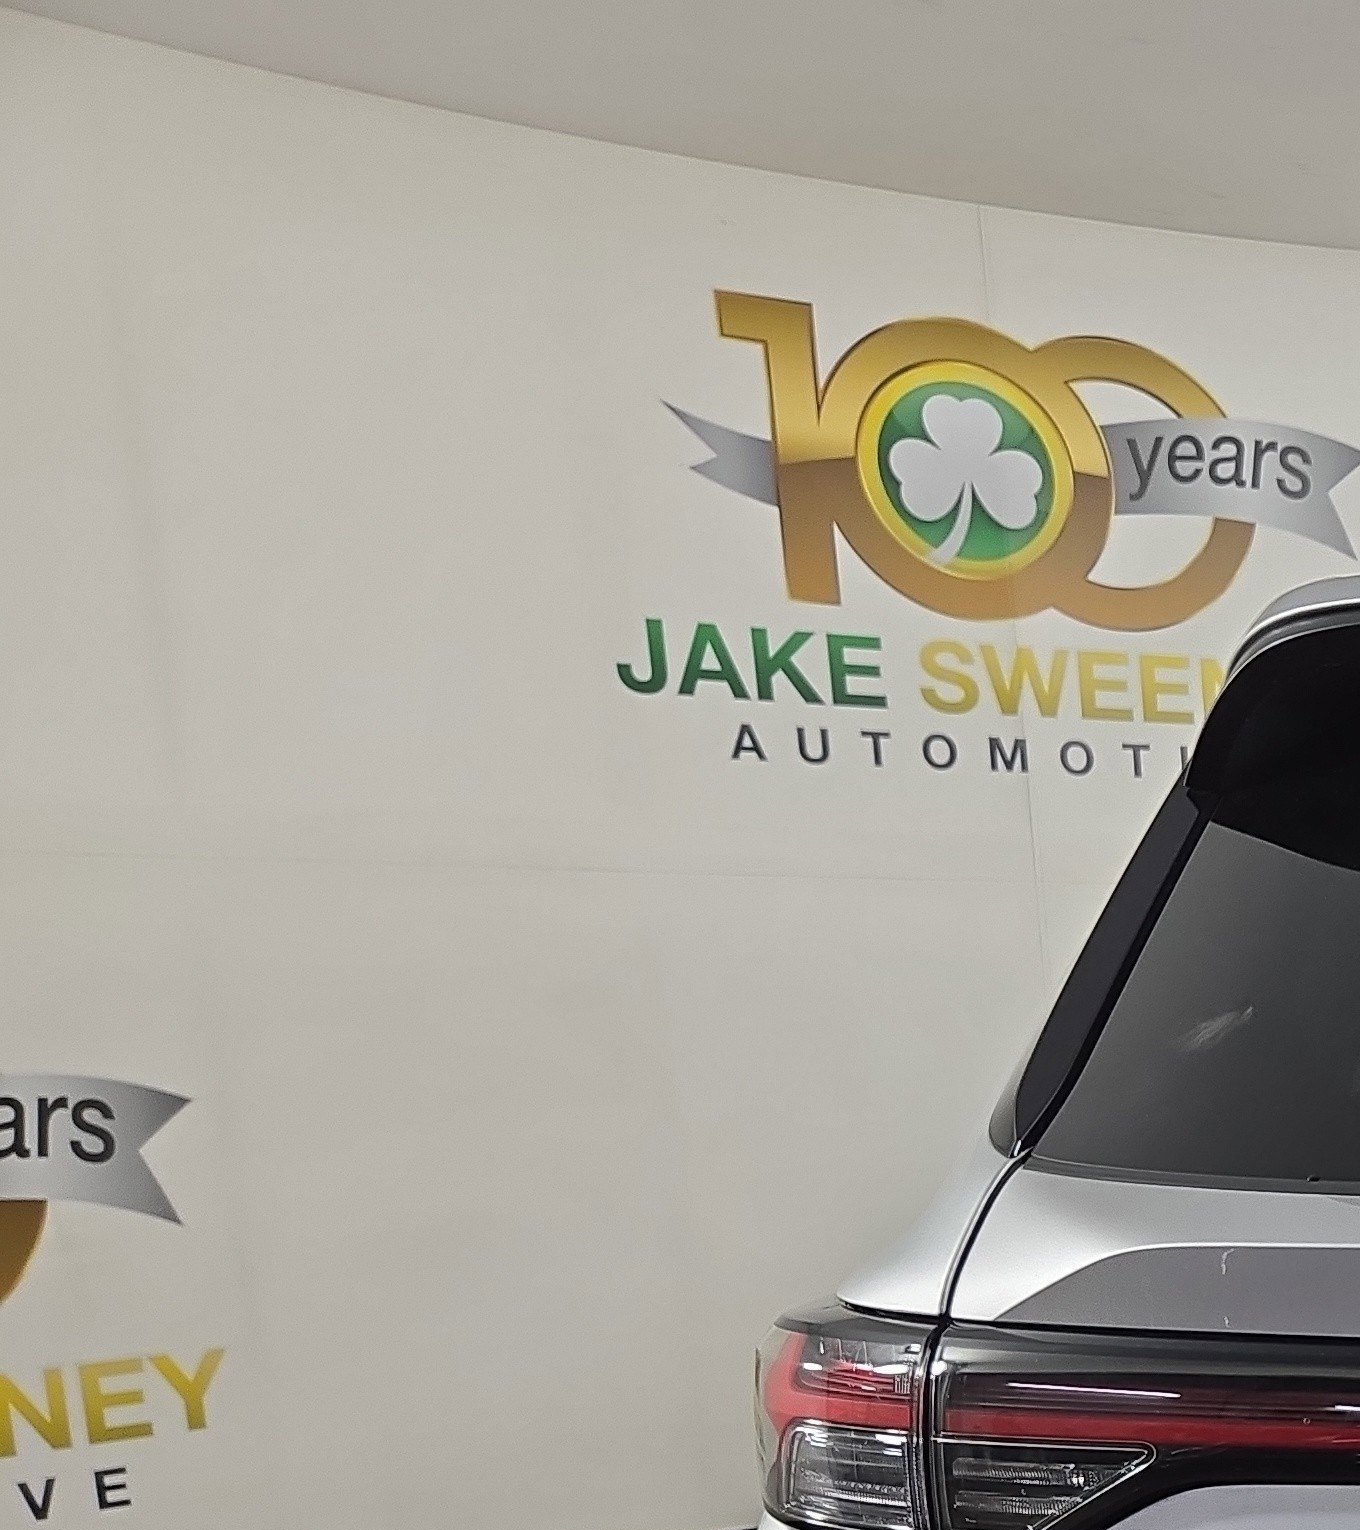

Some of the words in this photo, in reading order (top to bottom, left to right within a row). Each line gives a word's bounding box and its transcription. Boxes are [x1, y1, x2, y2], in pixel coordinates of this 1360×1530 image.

[714, 289, 1257, 633] 100
[1127, 433, 1313, 502] years
[616, 617, 889, 710] JAKE
